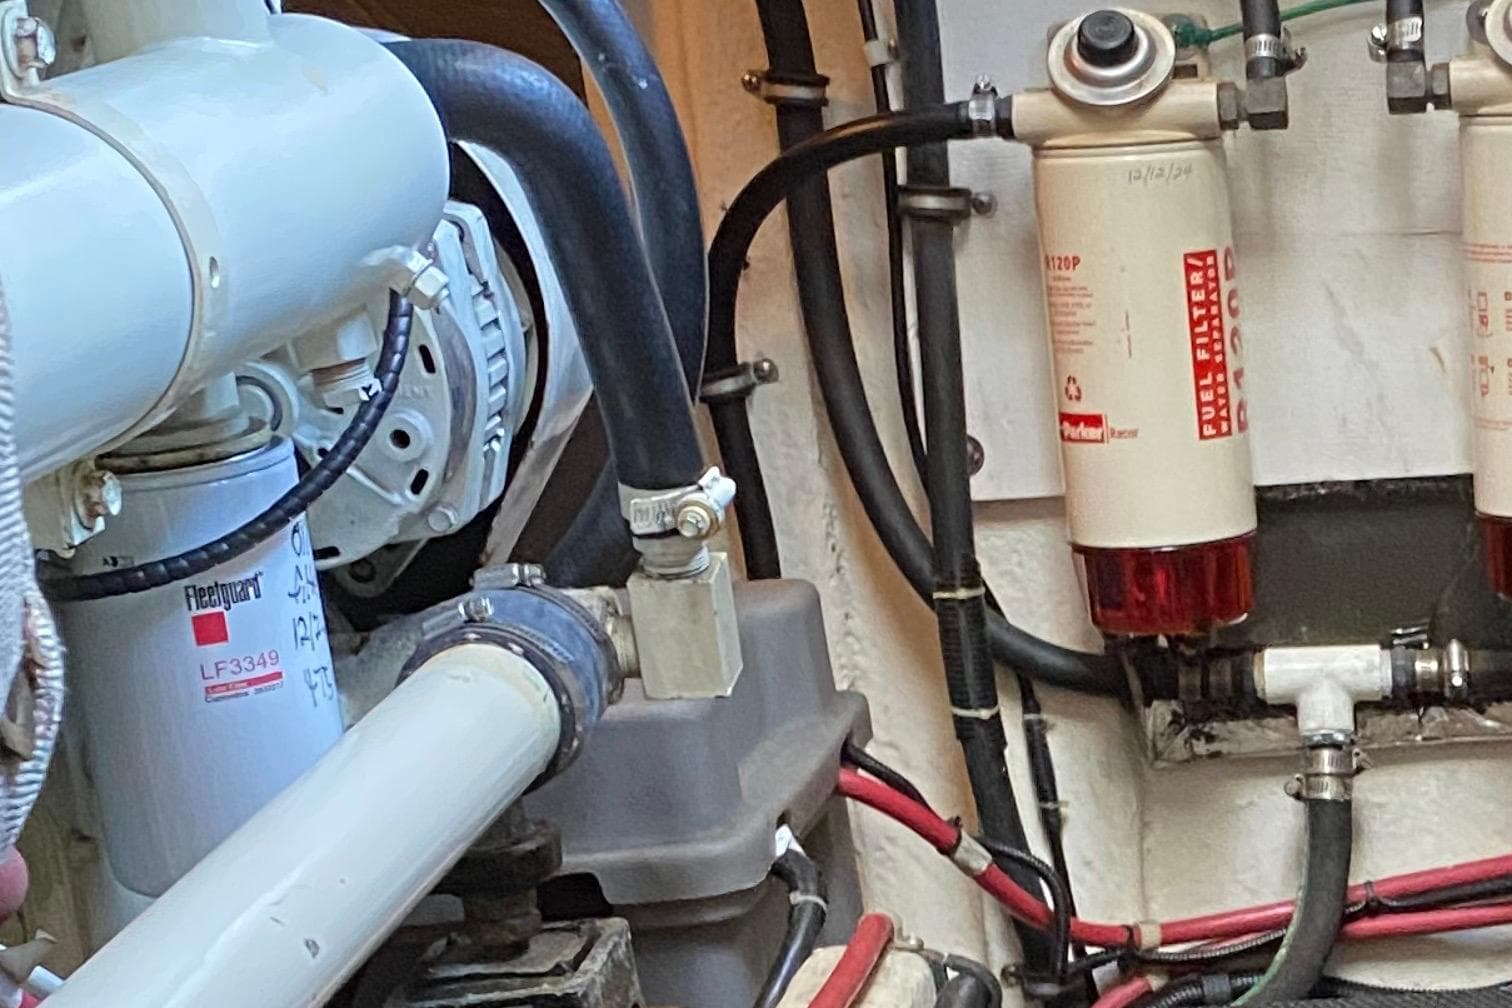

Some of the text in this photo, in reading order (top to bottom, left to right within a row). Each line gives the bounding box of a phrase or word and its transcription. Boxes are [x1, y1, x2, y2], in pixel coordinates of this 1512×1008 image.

[1186, 257, 1217, 436] FUEL FILTER/
[1206, 254, 1229, 433] WATER SEPARATOR
[184, 574, 262, 611] Fleetguard
[200, 649, 280, 680] LF3349
